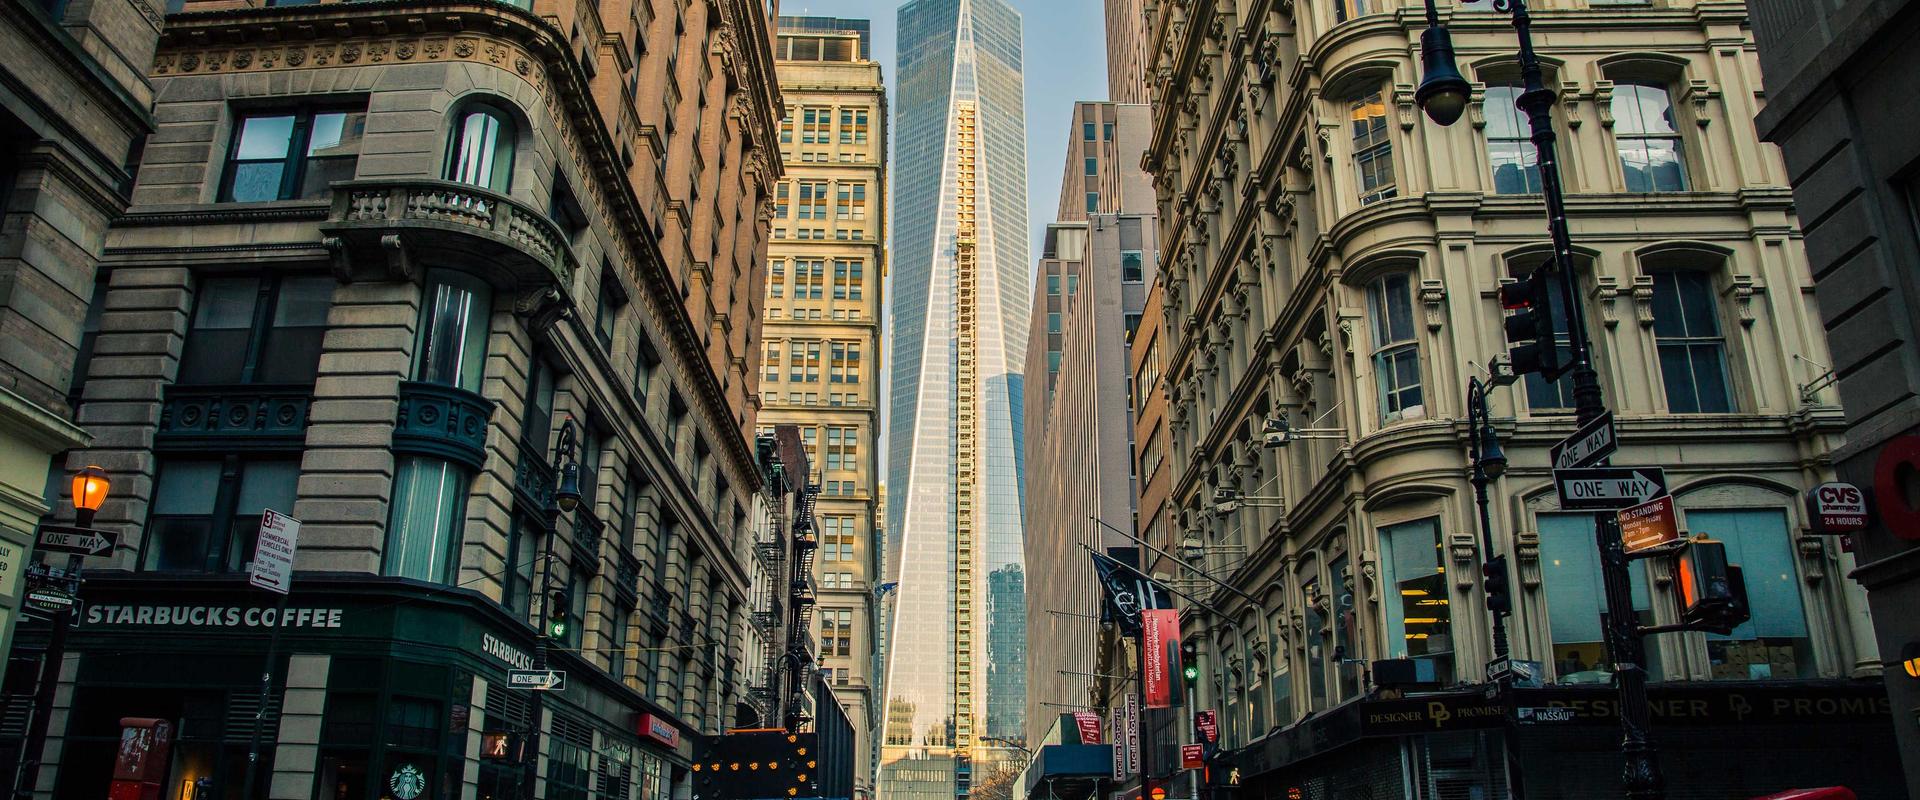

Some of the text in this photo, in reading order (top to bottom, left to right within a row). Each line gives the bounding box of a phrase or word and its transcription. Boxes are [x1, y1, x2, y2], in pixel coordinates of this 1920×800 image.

[1561, 428, 1606, 469] ONE WAY
[1573, 480, 1649, 497] ONE WAY
[1820, 487, 1860, 504] CVS
[1621, 502, 1664, 522] NO STANDING
[1823, 503, 1861, 512] pharmacy
[265, 512, 272, 527] 3
[1622, 520, 1642, 530] Monday
[1645, 514, 1662, 524] Friday
[1824, 517, 1863, 526] 24 HOURS
[47, 534, 104, 549] ONE WAY
[262, 531, 290, 546] COMMERCIAL
[262, 540, 293, 554] VEHICLES ONLY
[87, 604, 343, 628] STARBUCKS COFFEE
[483, 632, 531, 671] STARBUCKS
[516, 675, 556, 684] ONE WAY
[1370, 711, 1422, 724] DESIGNER
[1456, 704, 1504, 719] PROMISE
[1536, 711, 1570, 721] NASSAU
[1547, 700, 1709, 719] ESINER
[1114, 708, 1123, 747] Roberts
[1128, 694, 1138, 771] Lucille Roberts
